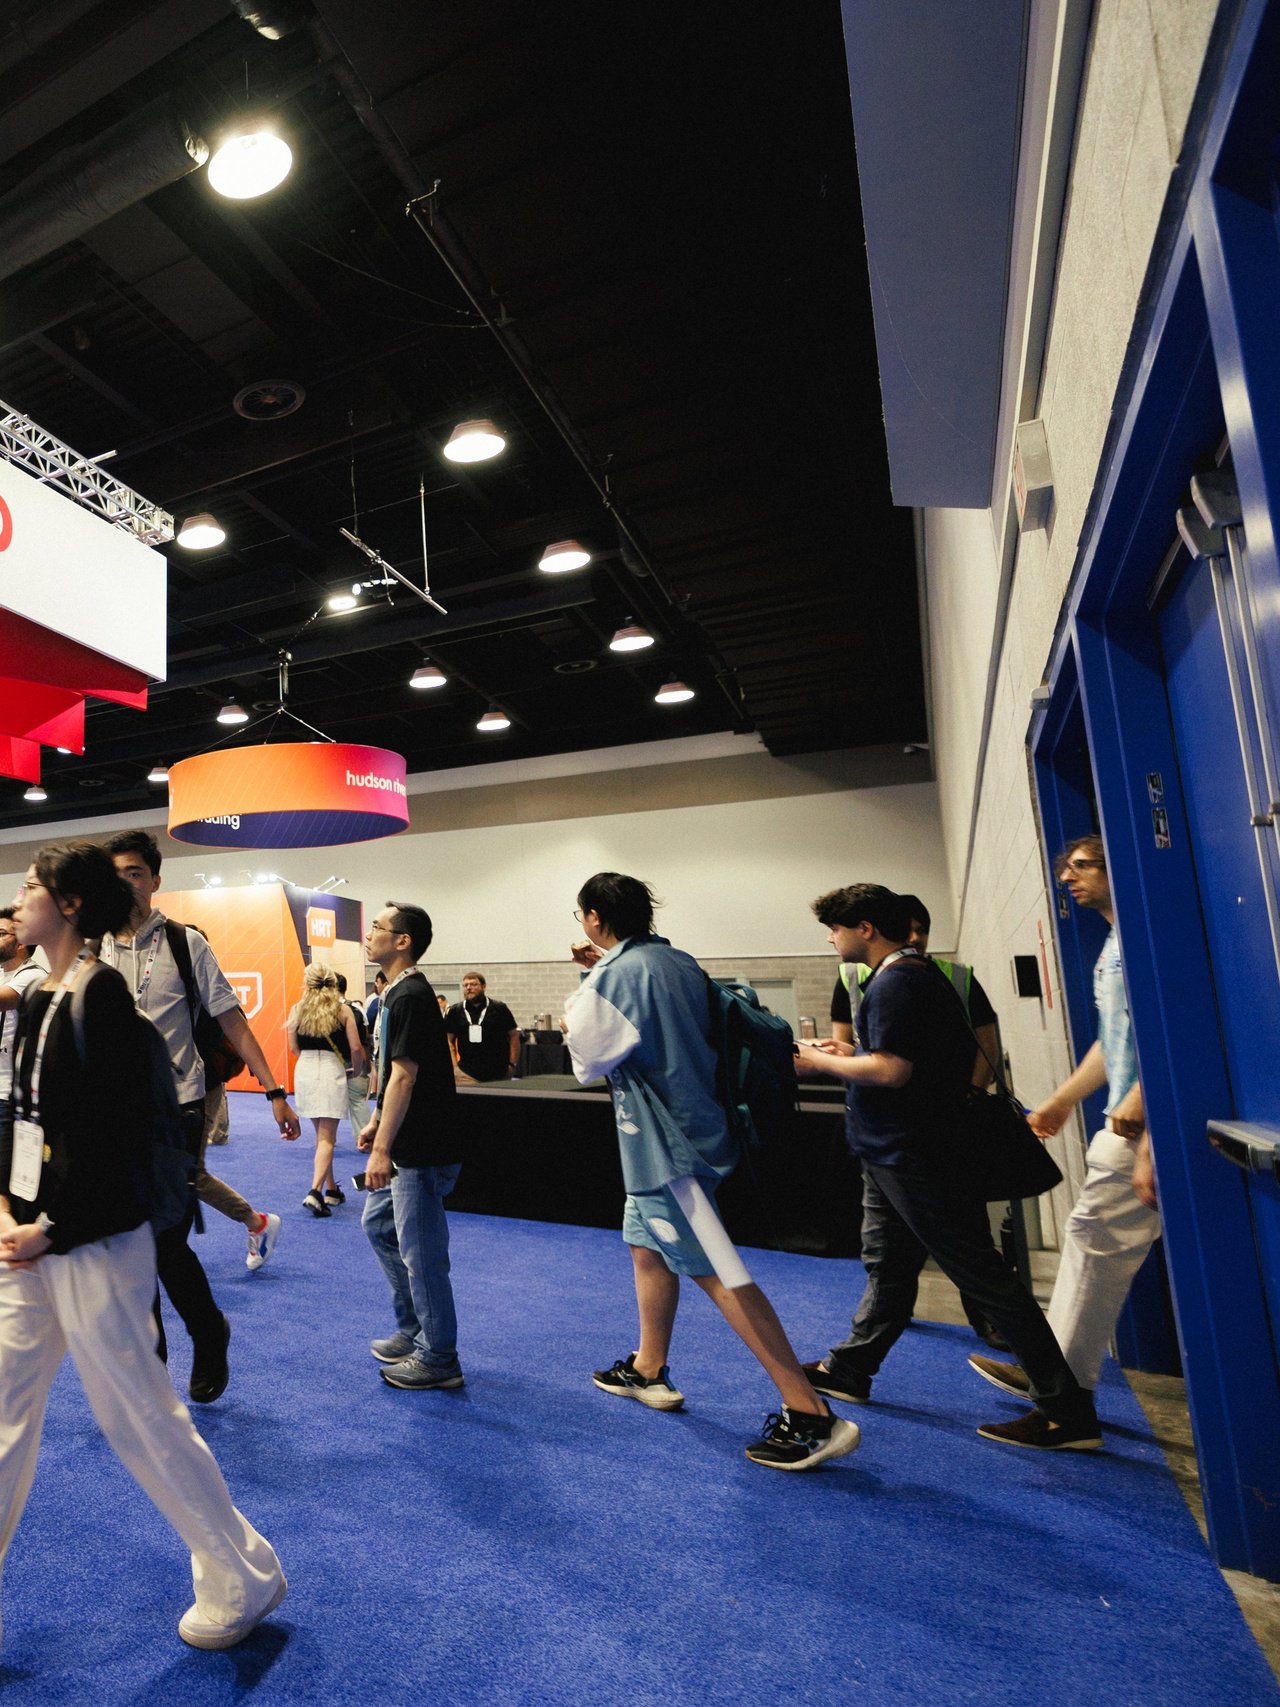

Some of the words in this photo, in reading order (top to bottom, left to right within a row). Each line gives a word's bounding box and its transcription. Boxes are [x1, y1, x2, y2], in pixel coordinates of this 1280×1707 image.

[346, 770, 392, 791] hudson
[393, 778, 407, 797] rive
[311, 918, 332, 938] HRT
